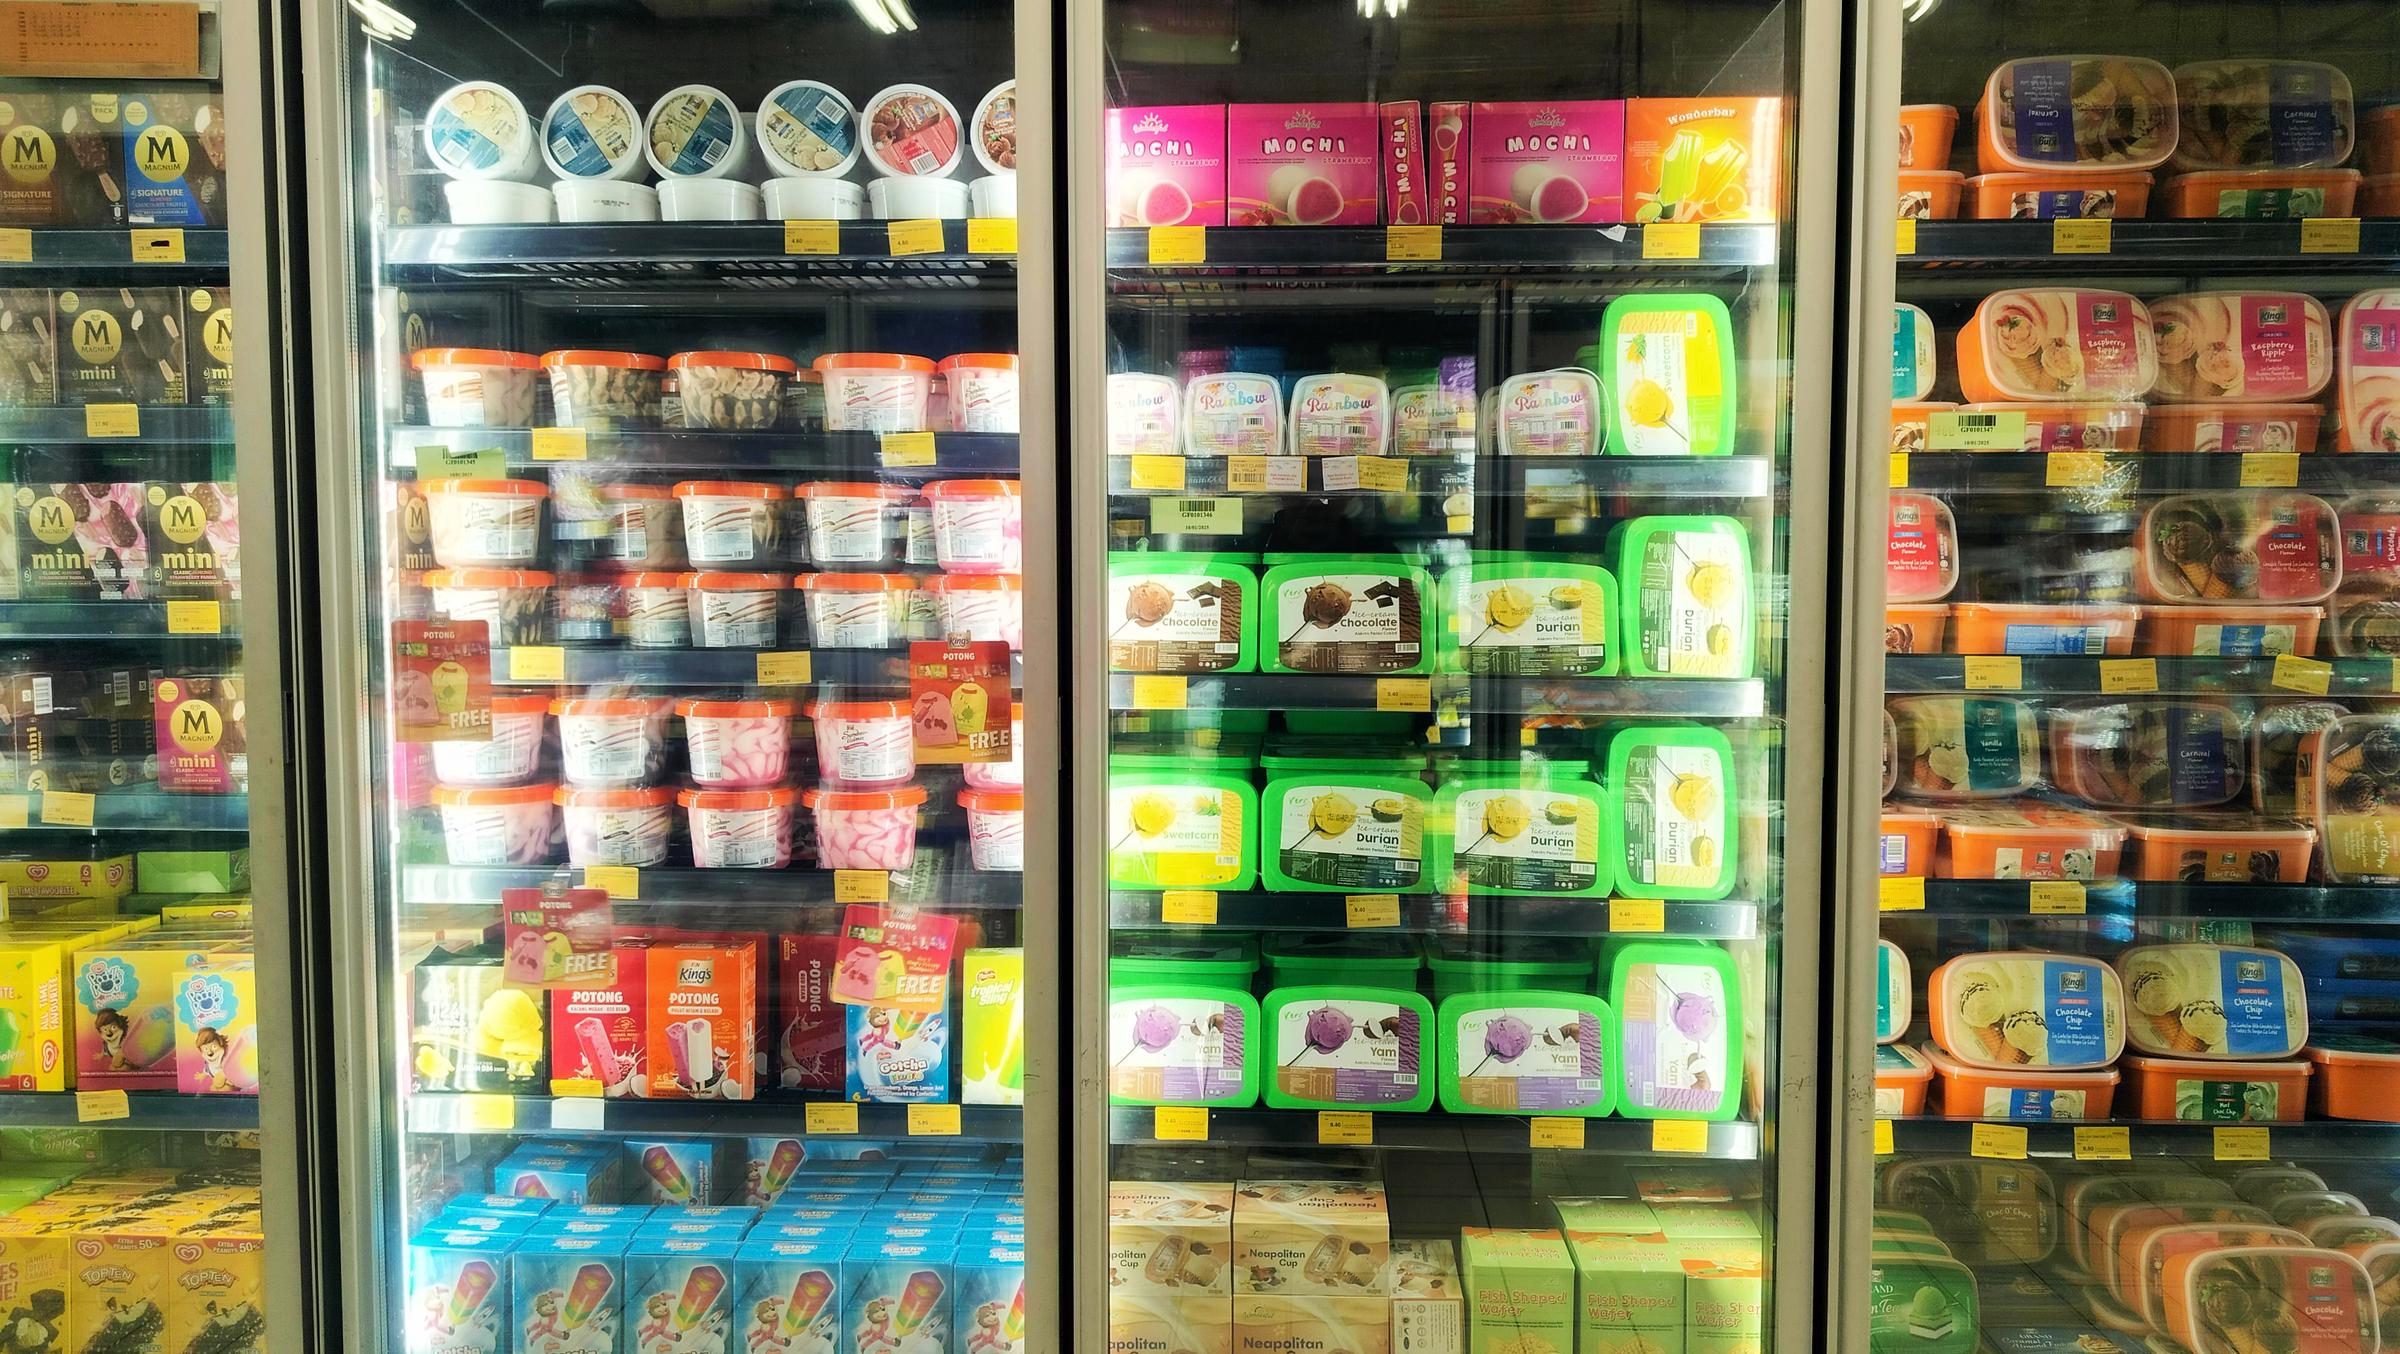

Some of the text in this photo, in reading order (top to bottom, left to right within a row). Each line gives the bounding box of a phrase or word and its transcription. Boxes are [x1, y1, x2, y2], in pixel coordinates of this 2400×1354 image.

[1667, 107, 1736, 125] Wonderbar
[2028, 109, 2058, 118] Carnival
[2284, 110, 2318, 119] Carnival
[14, 136, 43, 162] M
[147, 136, 176, 162] M
[1263, 137, 1345, 155] MOCHI
[1506, 135, 1591, 153] MOCHI
[1393, 118, 1411, 193] MOCHI
[11, 162, 47, 171] MAGNUM
[144, 162, 180, 171] MAGNUM
[4, 191, 52, 199] SIGNATURE
[138, 189, 183, 197] SIGNATURE
[83, 320, 110, 345] M
[82, 345, 114, 353] MAGNUM
[2088, 340, 2126, 349] Raspberry
[2251, 342, 2294, 352] Raspberry
[2261, 349, 2286, 358] Ripple
[80, 366, 116, 380] mini
[1200, 393, 1267, 411] Rainbow
[1310, 396, 1373, 412] Rainbow
[1515, 392, 1583, 411] Rainbow
[40, 506, 64, 527] M
[171, 505, 195, 527] M
[1891, 540, 1927, 550] Chocolate
[2269, 542, 2306, 552] Chocolate
[2388, 526, 2398, 561] Chocolate
[32, 548, 92, 568] mini
[163, 548, 223, 568] mini
[1162, 617, 1219, 628] Chocolate
[1340, 619, 1398, 627] Chocolate
[1536, 623, 1580, 632] Durian
[1683, 609, 1694, 652] Durian
[183, 709, 210, 734] M
[449, 709, 490, 729] FREE
[27, 727, 38, 765] mini
[969, 730, 1009, 751] FREE
[2180, 750, 2211, 758] Carnival
[179, 754, 216, 768] mini
[1357, 824, 1399, 833] Ice-cream
[1162, 830, 1219, 840] Sweetcorn
[1356, 833, 1399, 845] Durian
[1531, 836, 1574, 847] Durian
[1668, 822, 1677, 864] Durian
[82, 867, 89, 877] 6
[883, 921, 917, 931] POTONG
[564, 952, 609, 974] FREE
[679, 967, 712, 984] King's
[809, 959, 821, 1012] POTONG
[895, 975, 941, 994] FREE
[571, 991, 623, 1003] POTONG
[669, 993, 719, 1004] POTONG
[2234, 998, 2272, 1007] Chocolate
[2055, 1008, 2093, 1018] Chocolate
[2245, 1006, 2263, 1015] Chip
[2065, 1016, 2083, 1026] Chip
[1370, 1047, 1396, 1057] Yam
[1551, 1053, 1579, 1065] Yam
[879, 1058, 928, 1074] Gotcha
[23, 1079, 30, 1088] 6
[1249, 1249, 1306, 1261] Neapolitan
[1120, 1259, 1139, 1270] Cup
[1279, 1258, 1298, 1269] Cup
[1479, 1290, 1567, 1305] Fish Shaped
[1587, 1293, 1676, 1310] Fish Shaped
[1479, 1304, 1525, 1317] Wafer
[1588, 1307, 1632, 1321] Wafer
[2305, 1306, 2344, 1315] Chocolate
[1696, 1315, 1740, 1327] Wafer
[1243, 1337, 1323, 1352] Neapolitan
